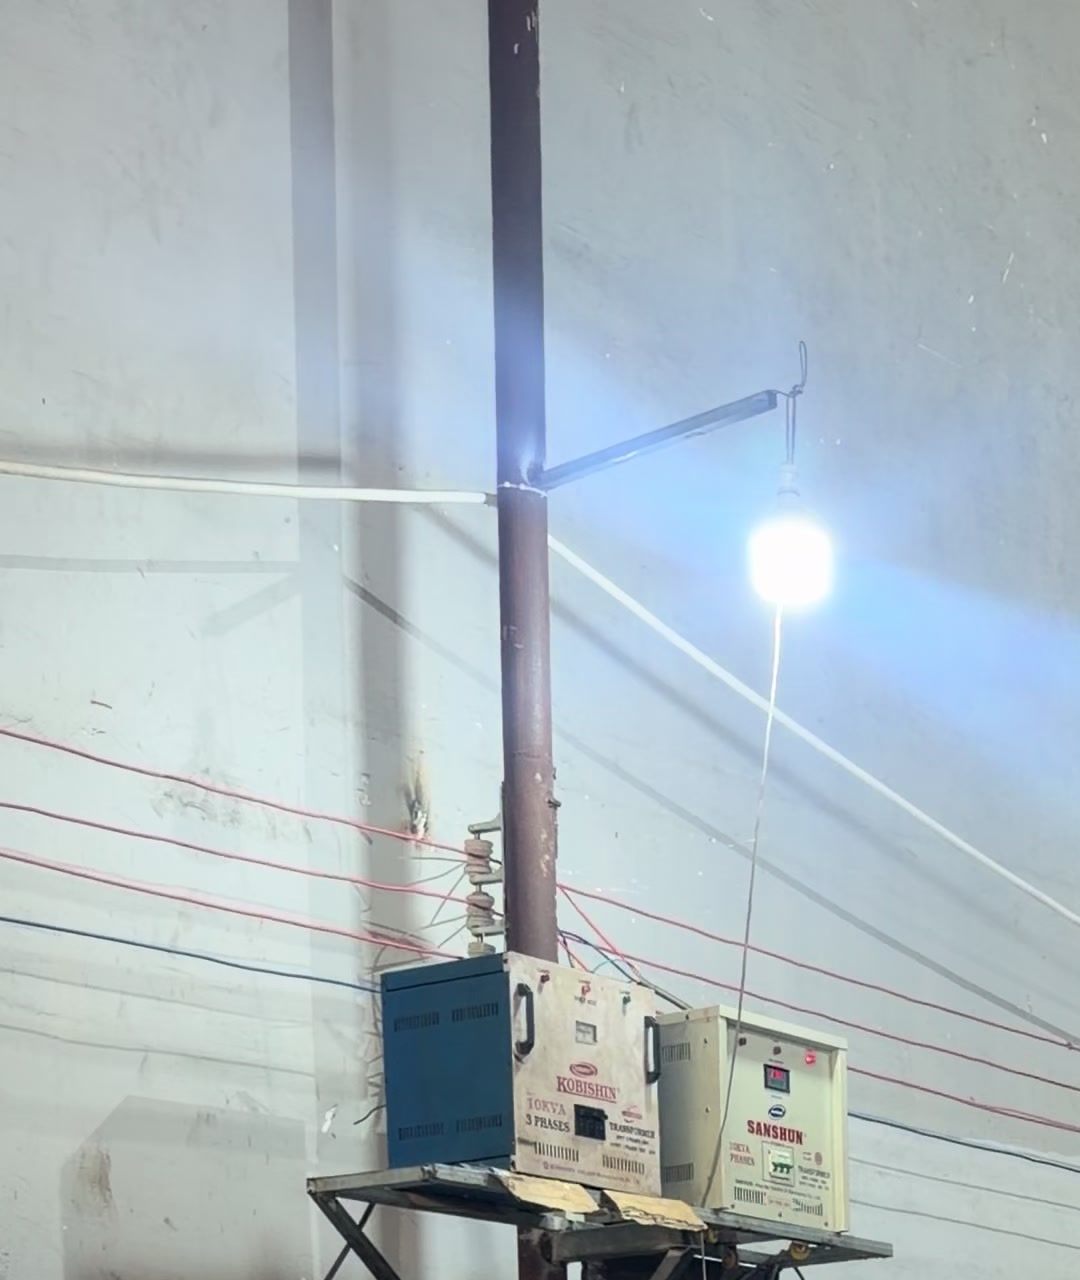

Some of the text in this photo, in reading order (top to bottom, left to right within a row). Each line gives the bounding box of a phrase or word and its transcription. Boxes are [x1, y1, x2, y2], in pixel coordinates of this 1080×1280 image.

[556, 1076, 617, 1100] KOBISHIN
[526, 1113, 571, 1133] 3 PHASES
[746, 1119, 804, 1145] SANSHUN
